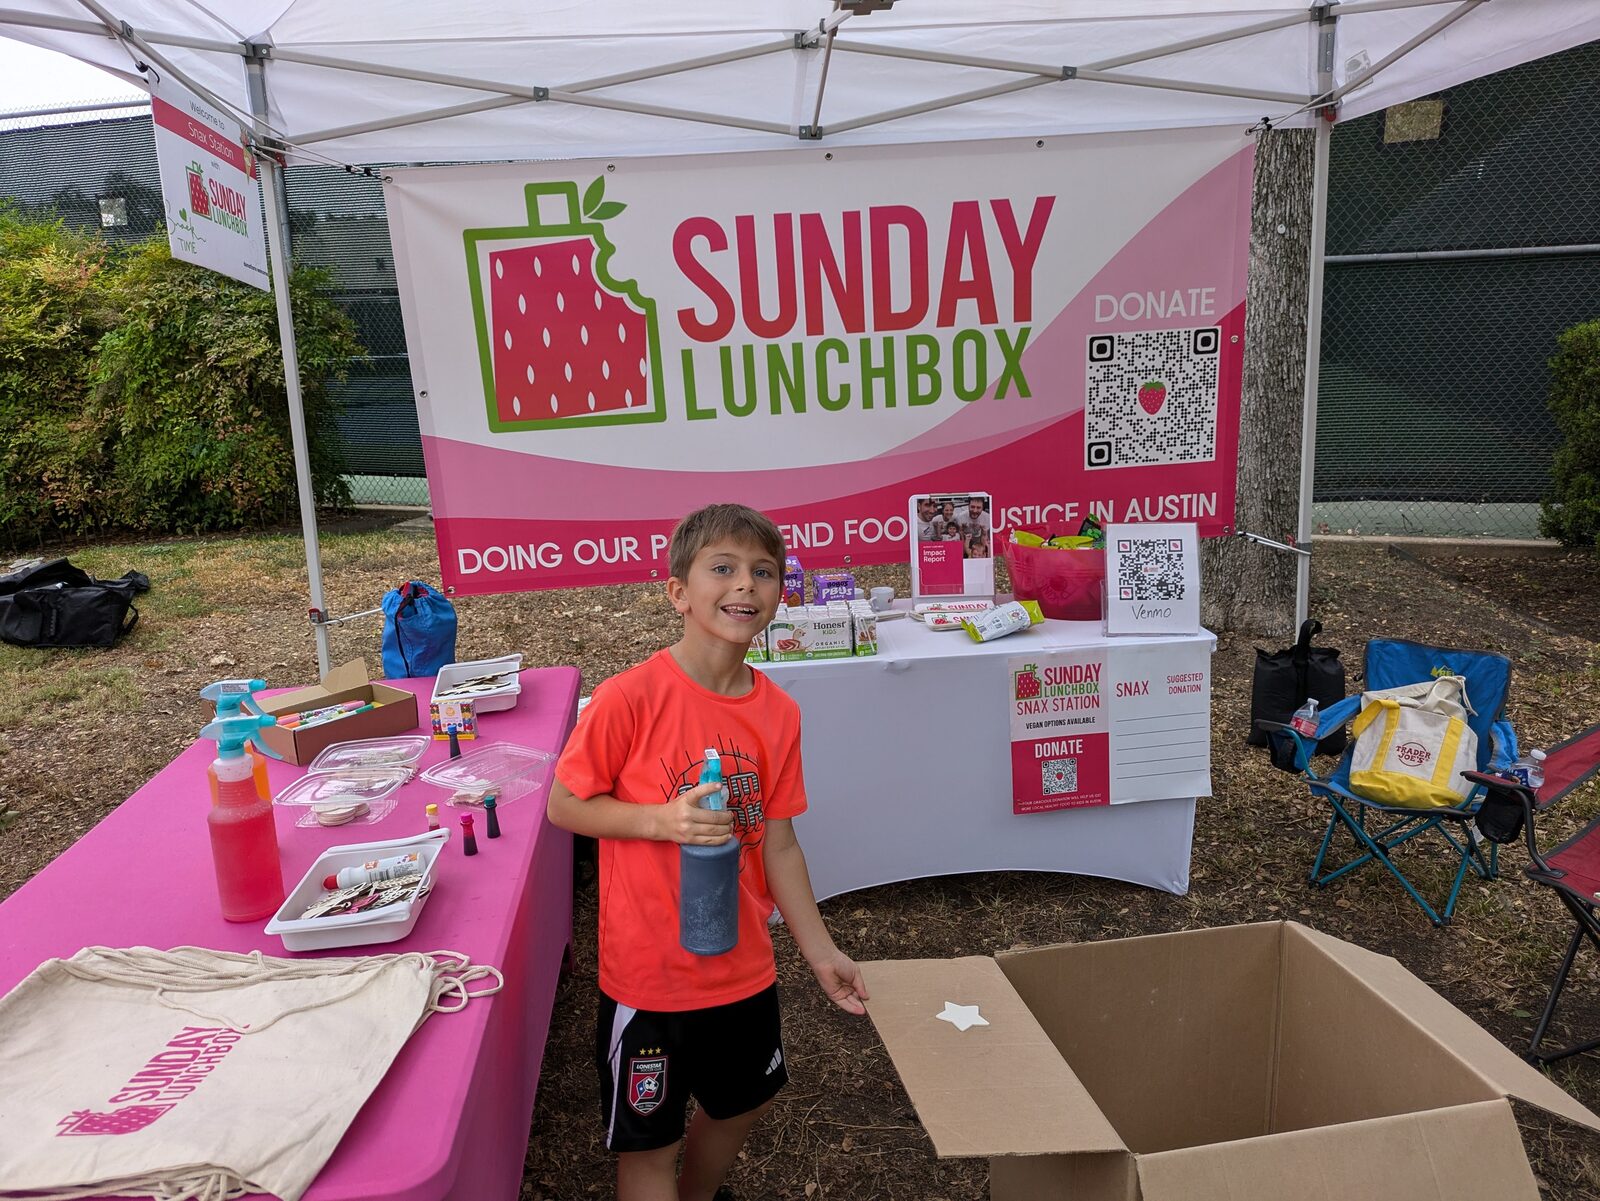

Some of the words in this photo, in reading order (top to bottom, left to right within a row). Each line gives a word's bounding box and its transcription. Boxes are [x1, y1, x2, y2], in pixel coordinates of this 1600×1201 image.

[189, 100, 218, 125] Welcome
[218, 119, 225, 130] to
[188, 121, 208, 145] Snax
[208, 134, 234, 161] Station
[208, 178, 247, 222] SUNDAY
[212, 205, 249, 238] LUNCHBOX
[177, 237, 198, 254] TIME
[672, 195, 1056, 344] SUNDAY
[1094, 287, 1216, 323] DONATE
[680, 327, 1032, 421] LUNCHBOX
[844, 515, 908, 545] FOO
[1089, 500, 1114, 523] IN
[1123, 492, 1217, 523] AUSTIN
[457, 541, 563, 575] DOING
[573, 536, 642, 566] OUR
[923, 549, 946, 558] Impact
[947, 602, 988, 610] SUNDAY
[1131, 603, 1172, 620] Venmo
[813, 620, 846, 630] Honest
[1044, 662, 1102, 686] SUNDAY
[1166, 672, 1204, 684] SUGGESTED
[1044, 682, 1100, 699] LUNCHBOX
[1116, 680, 1149, 698] SNAX
[1168, 684, 1201, 695] DONATION
[1016, 698, 1049, 716] SNAX
[1052, 694, 1100, 712] STATION
[1025, 720, 1044, 730] VEGAN
[1044, 718, 1066, 728] OPTIONS
[1067, 716, 1096, 726] AVAILABLE
[1034, 739, 1084, 759] DONATE
[1395, 745, 1431, 760] TRADER
[1398, 754, 1425, 765] JOE'S
[108, 1026, 223, 1103] SUNDAY
[636, 1062, 662, 1070] LONESTAR
